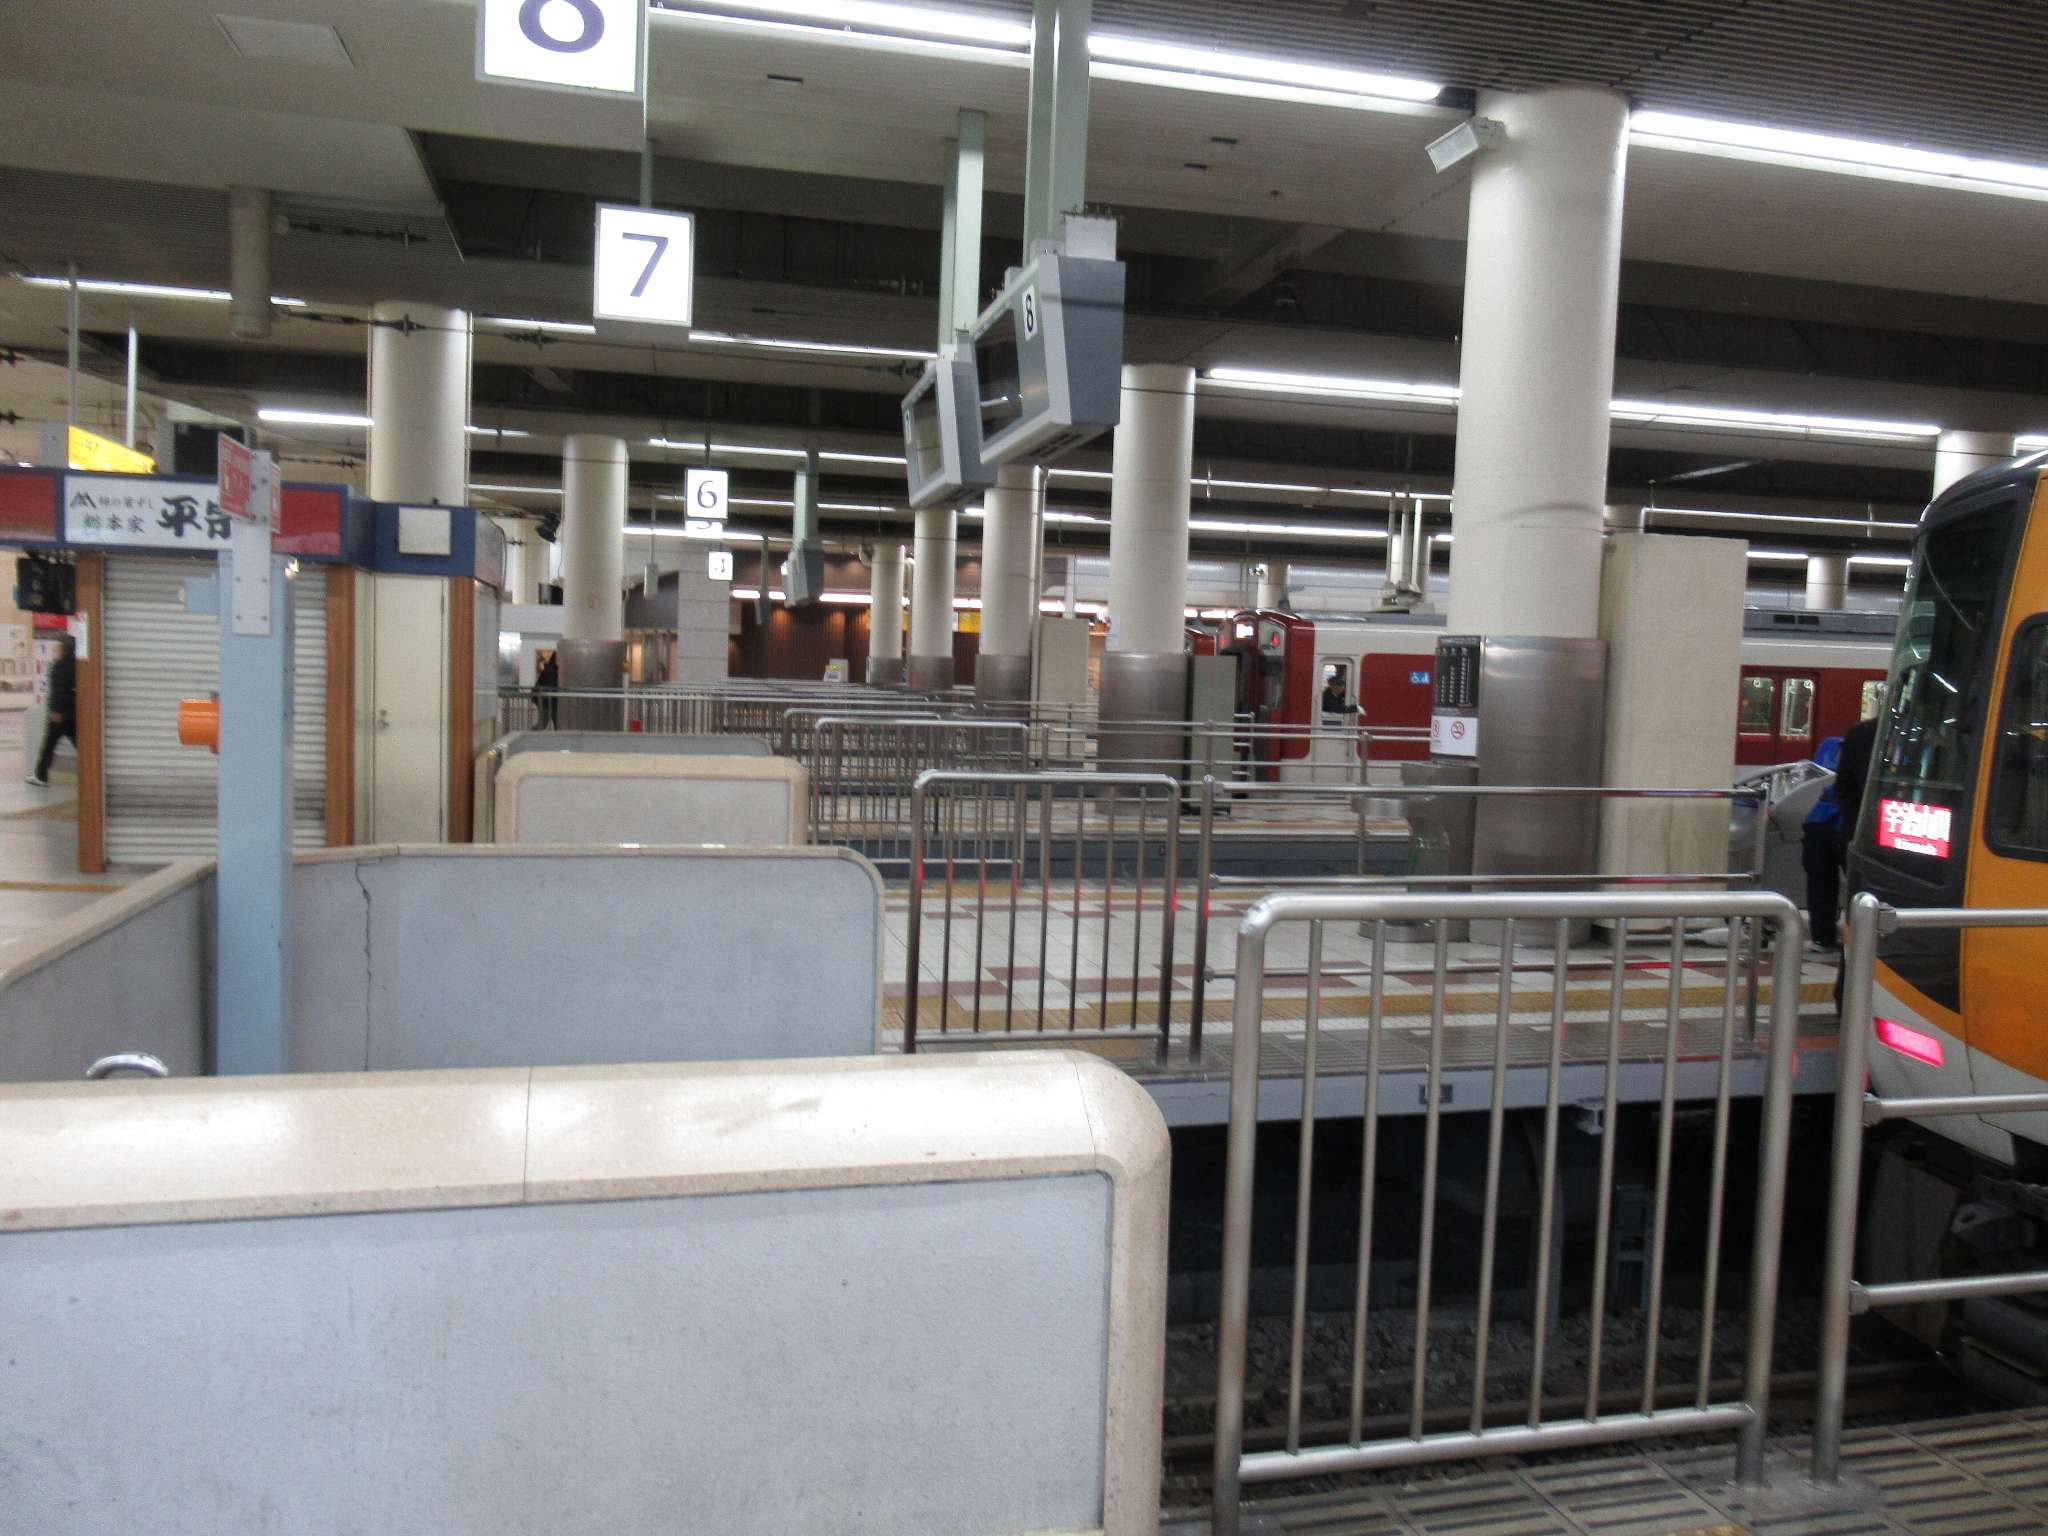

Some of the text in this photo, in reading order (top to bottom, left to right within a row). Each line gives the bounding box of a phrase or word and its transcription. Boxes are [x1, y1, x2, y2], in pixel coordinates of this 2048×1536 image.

[622, 232, 669, 298] 7
[1025, 293, 1034, 333] 8
[697, 480, 718, 509] 6
